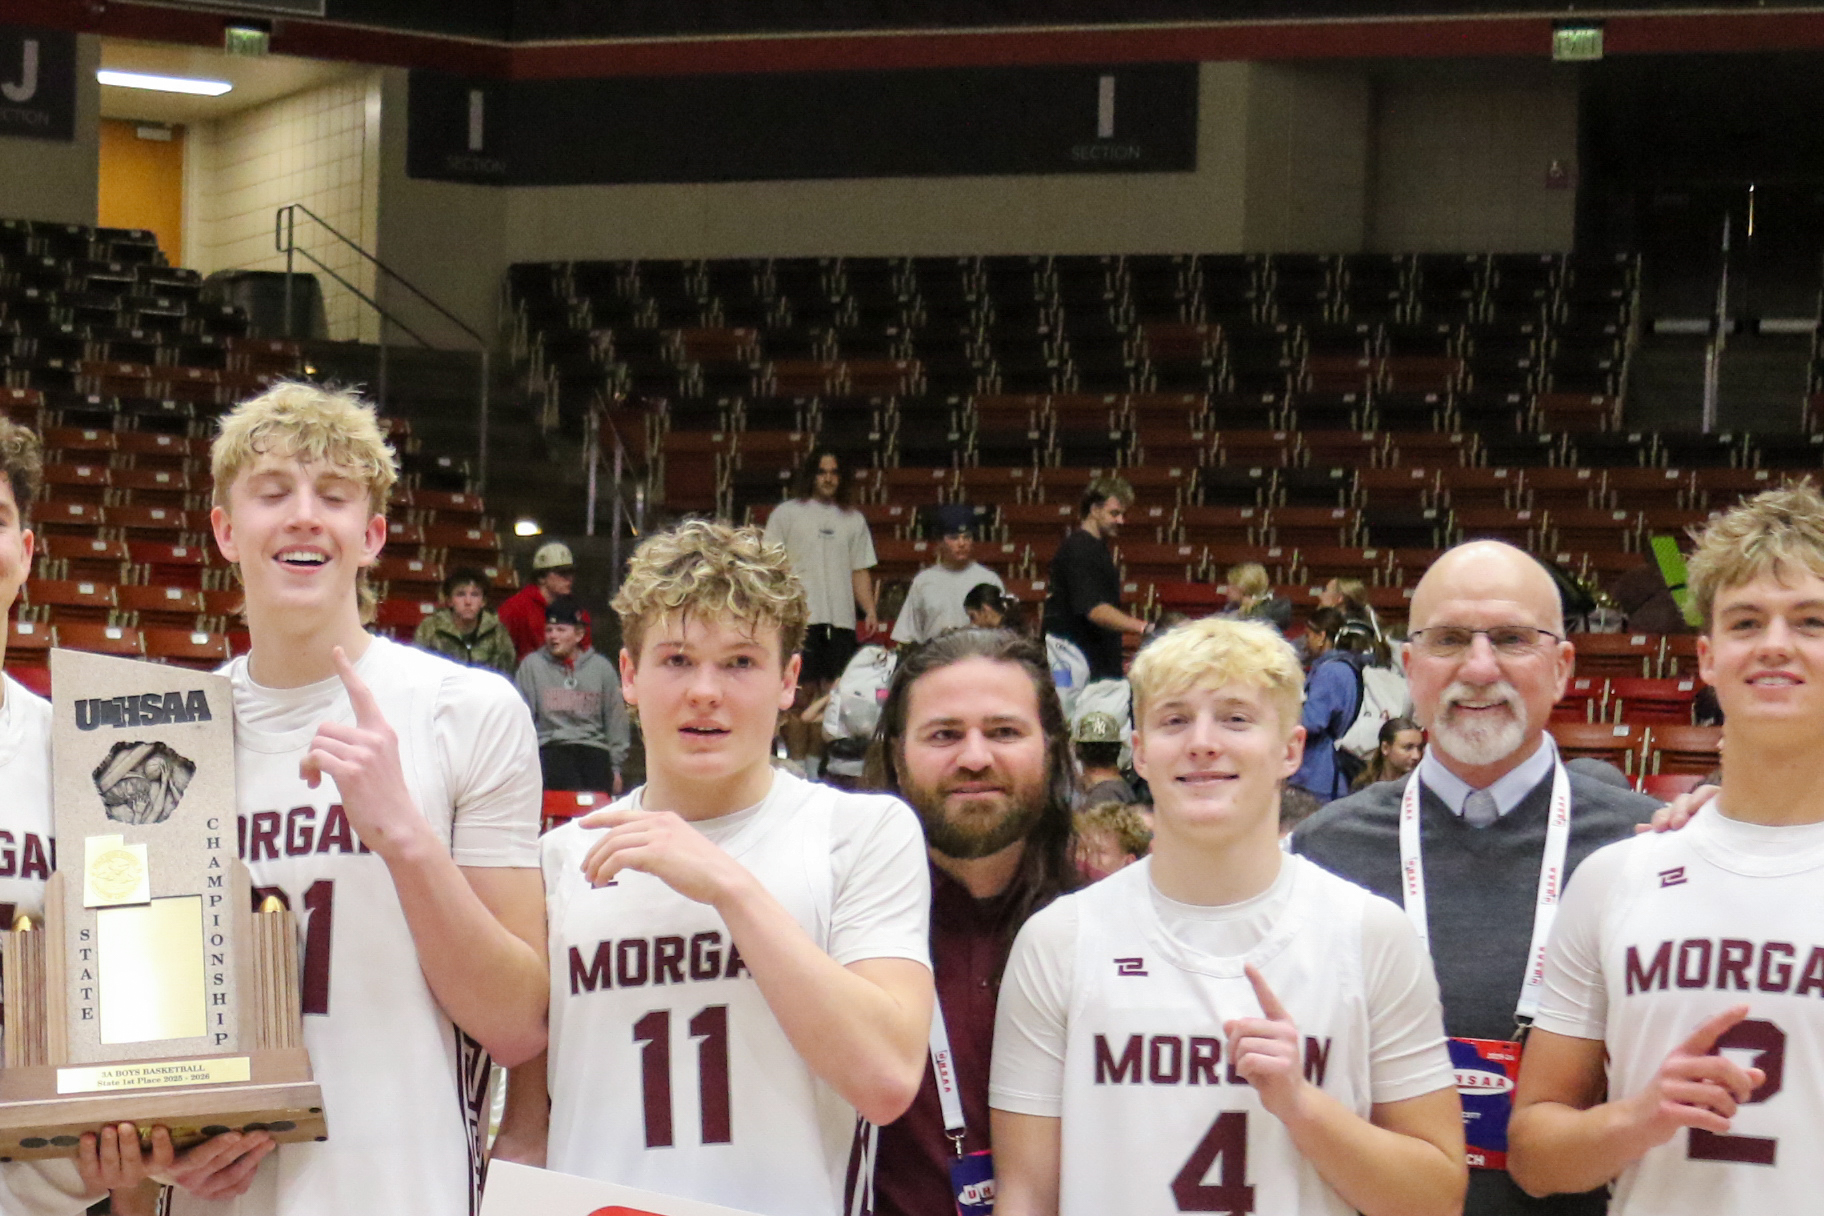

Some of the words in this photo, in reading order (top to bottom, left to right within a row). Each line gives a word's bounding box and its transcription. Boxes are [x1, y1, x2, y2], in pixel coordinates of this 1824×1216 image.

[1, 40, 39, 101] J
[1071, 144, 1140, 161] SECTION
[206, 817, 230, 1046] CHAMPIONSHIP
[79, 928, 94, 1021] STATE
[97, 1079, 120, 1087] State
[122, 1077, 135, 1085] 1st
[137, 1076, 161, 1085] Place
[164, 1075, 183, 1083] 2025
[190, 1073, 210, 1081] 2026
[101, 1070, 113, 1078] 3A
[115, 1068, 140, 1077] BOYS
[143, 1064, 206, 1076] BASKETBALL
[632, 1003, 734, 1151] 11
[1094, 1032, 1333, 1088] MORN
